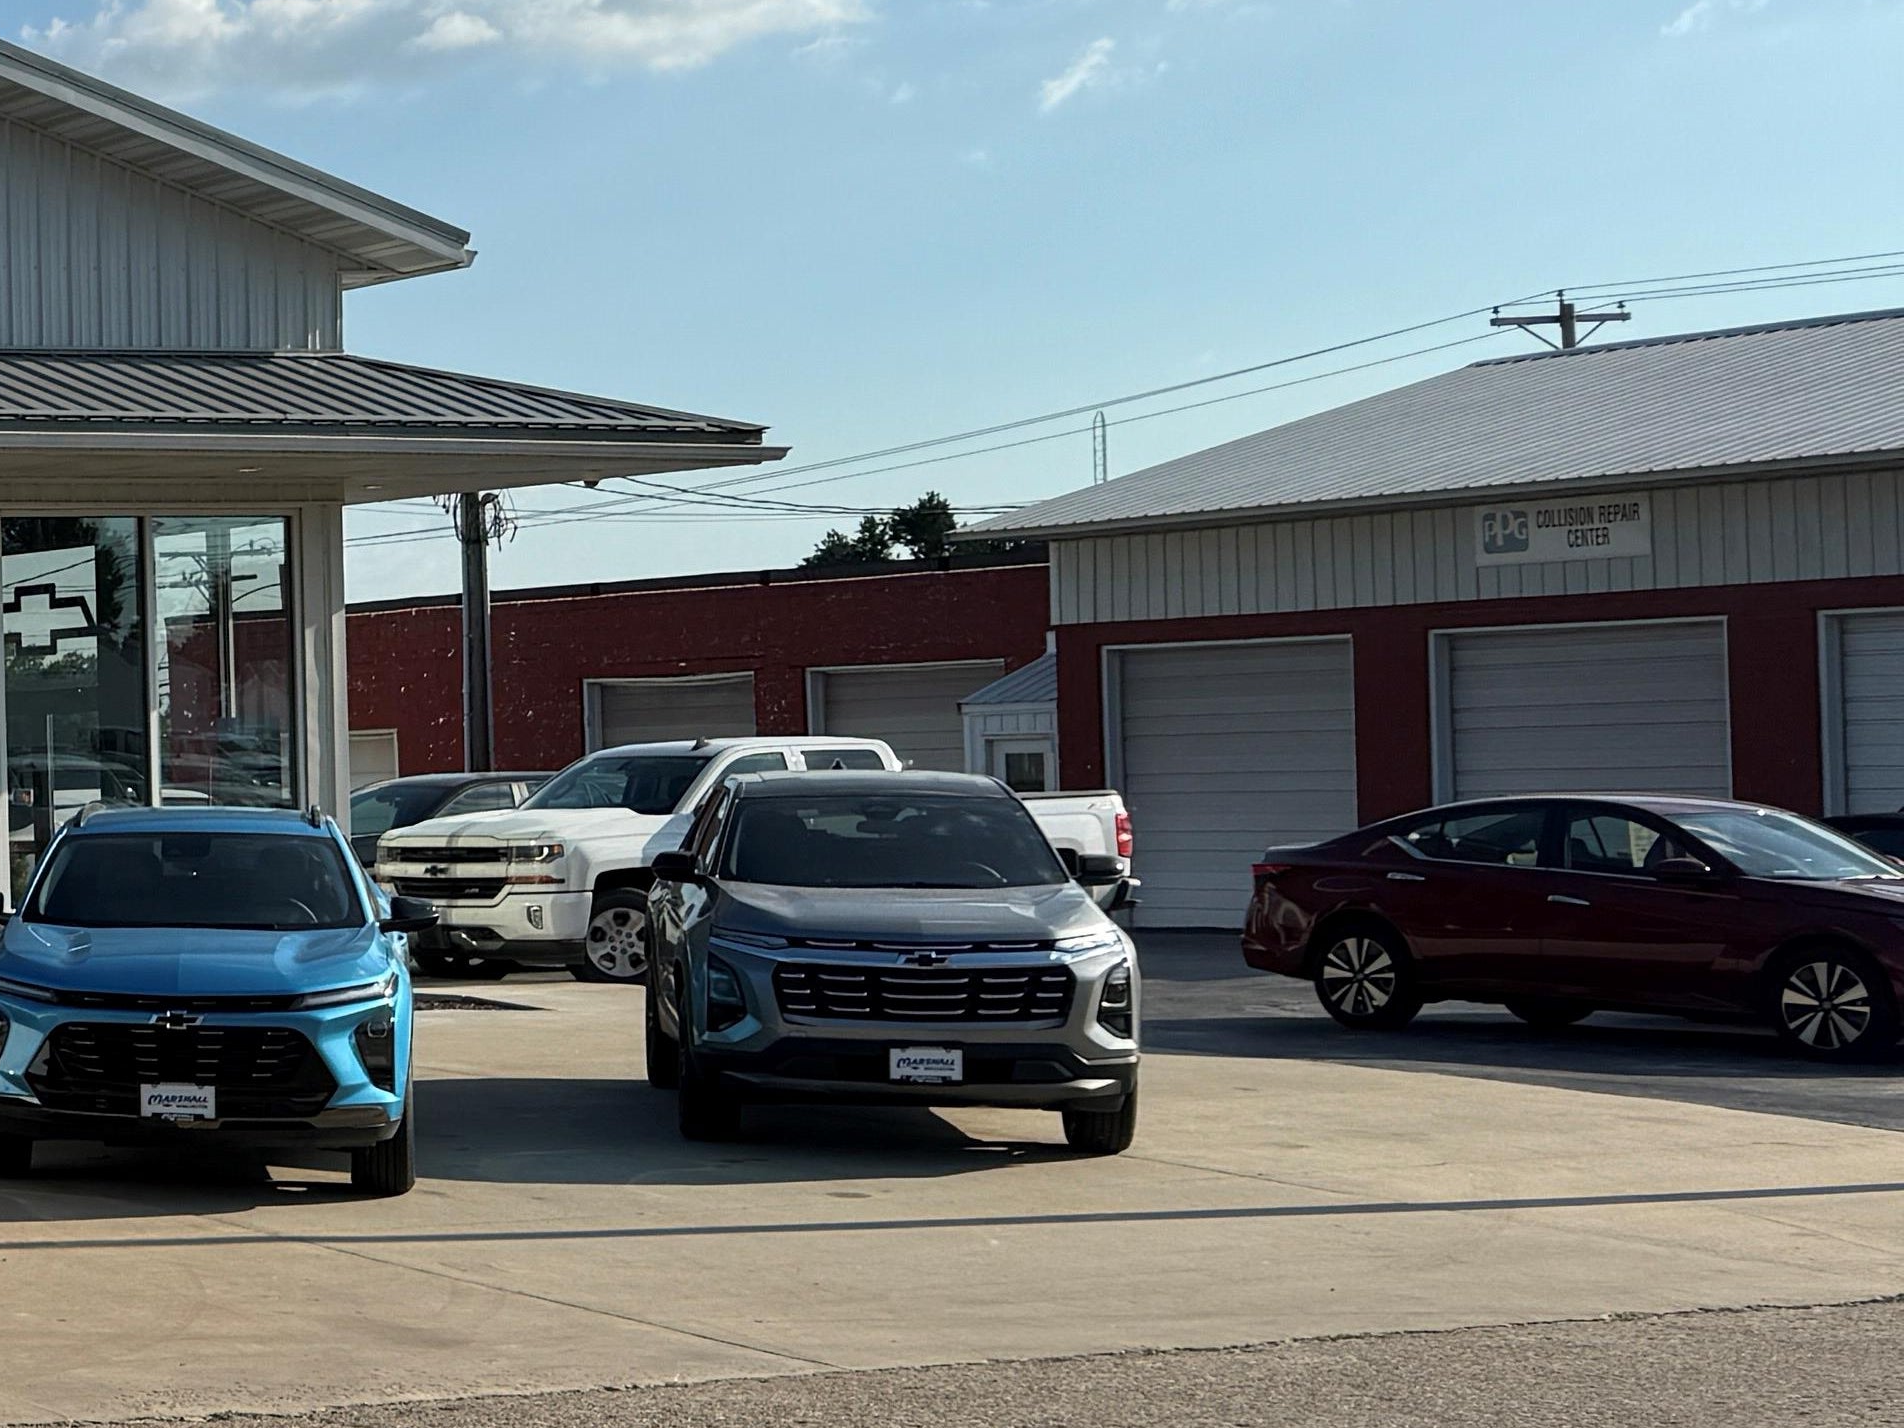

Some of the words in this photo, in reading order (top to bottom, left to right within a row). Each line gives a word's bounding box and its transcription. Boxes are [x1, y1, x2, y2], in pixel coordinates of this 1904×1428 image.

[1484, 510, 1528, 546] PPG
[1536, 506, 1594, 529] COLLISION
[1599, 502, 1640, 523] REPAIR
[1567, 526, 1610, 548] CENTER
